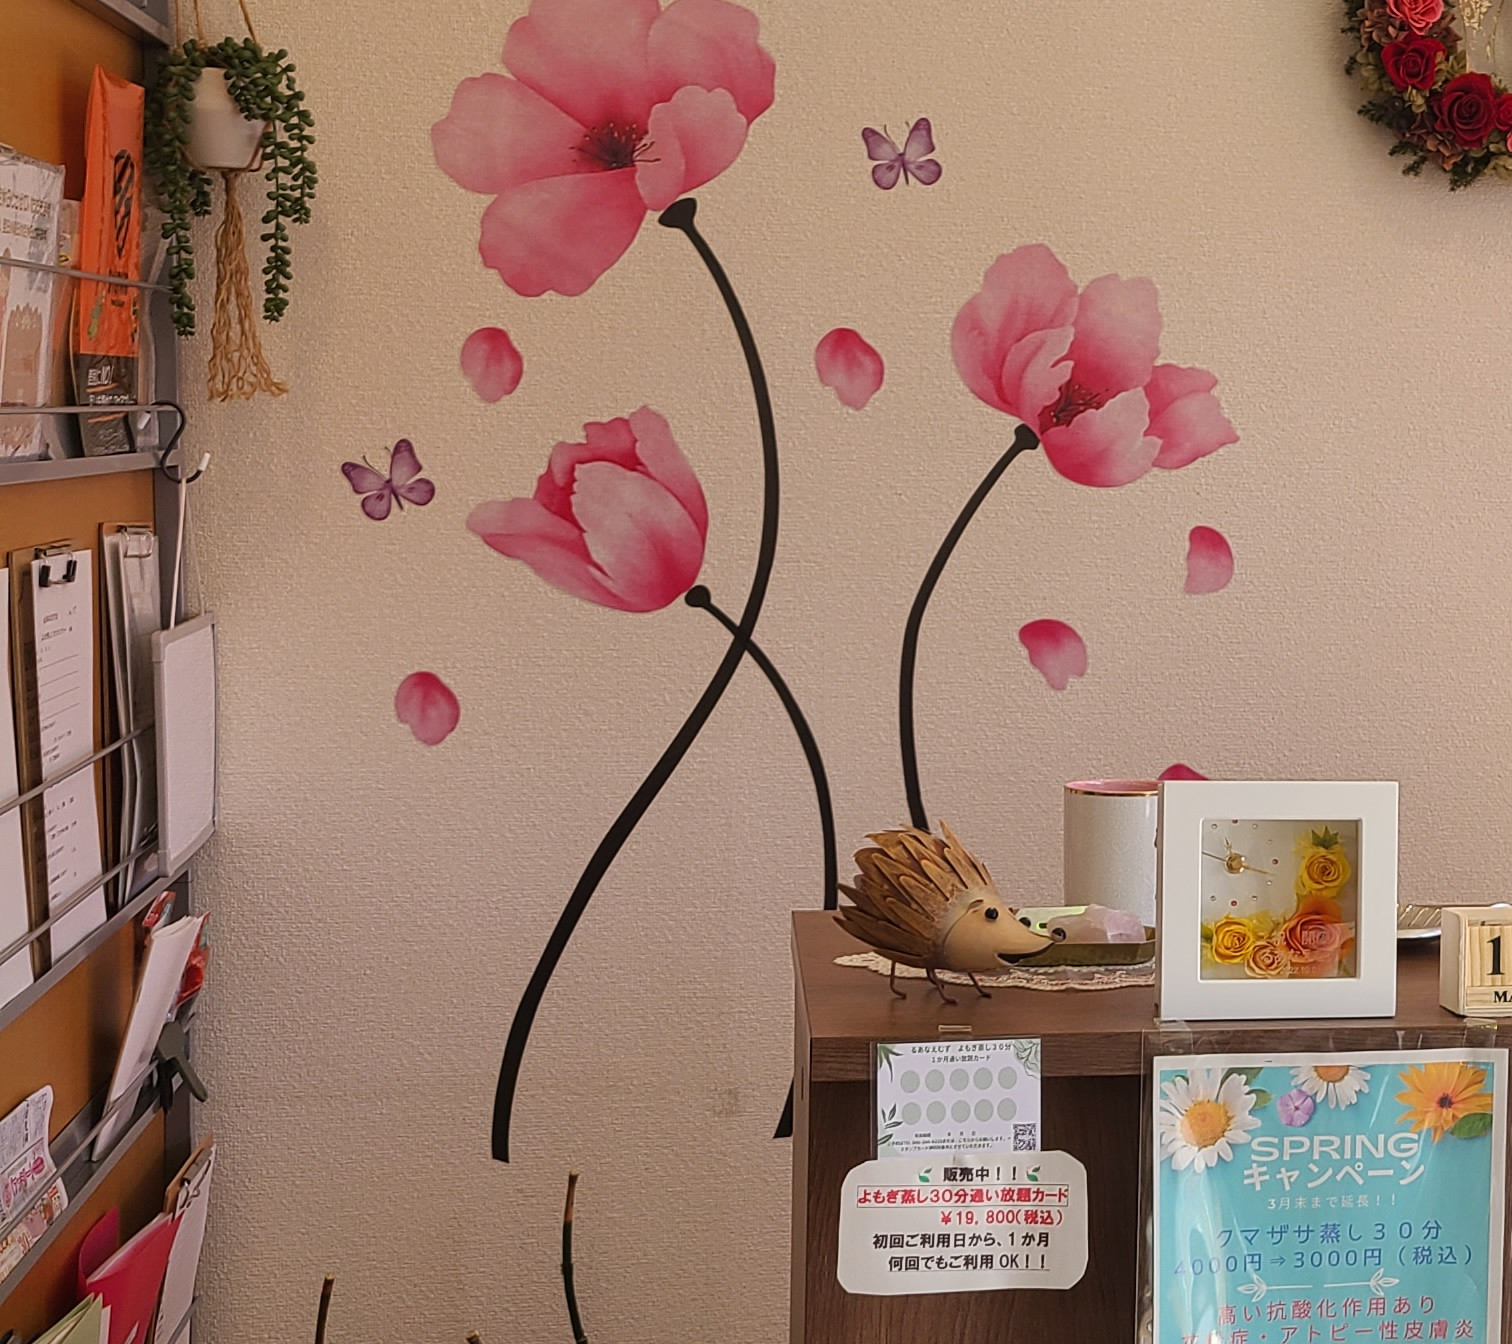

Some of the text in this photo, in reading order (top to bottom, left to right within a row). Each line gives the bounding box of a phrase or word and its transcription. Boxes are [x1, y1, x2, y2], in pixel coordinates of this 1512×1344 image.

[1486, 935, 1505, 975] 1
[1250, 1132, 1419, 1162] SPRING
[943, 1166, 1018, 1183] 販売中！！
[1243, 1162, 1425, 1192] キャンペーン
[858, 1187, 1068, 1205] よもぎ蒸し30分通い放題カード
[1267, 1192, 1397, 1211] 3月末まで延長！！
[872, 1231, 1050, 1249] 初回ご利用日から、1か月
[1217, 1221, 1443, 1248] クマザサ蒸し30分
[1218, 1296, 1435, 1325] 高い抗酸化作用あり
